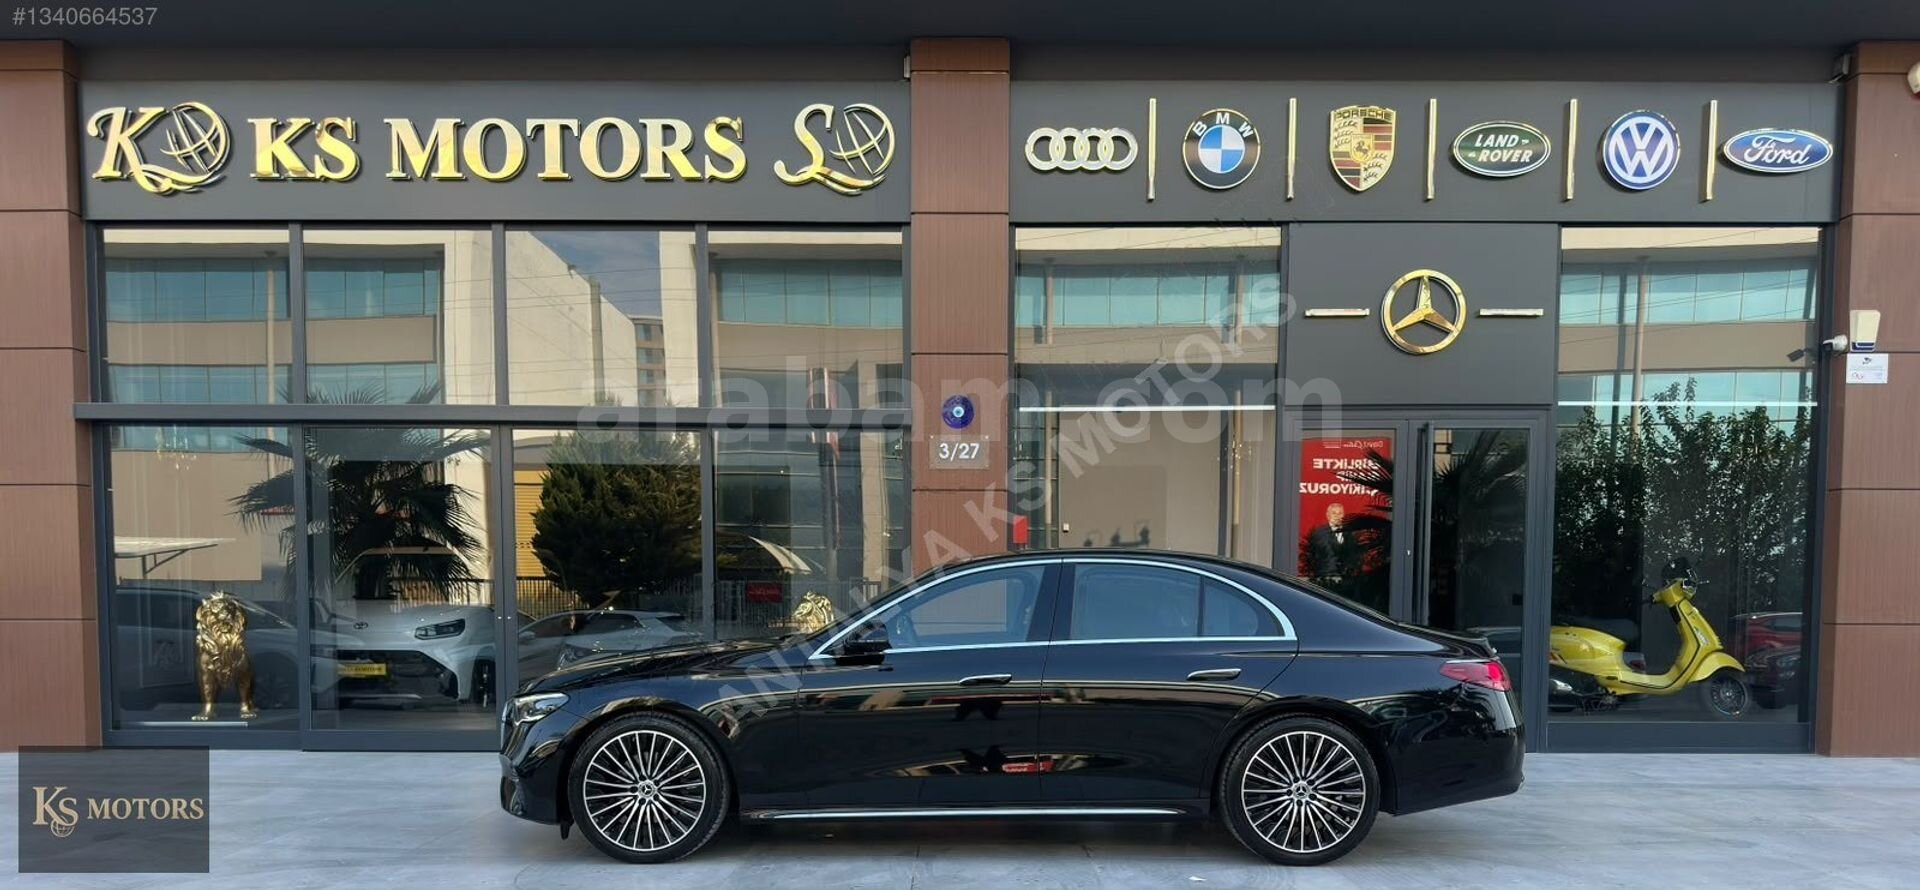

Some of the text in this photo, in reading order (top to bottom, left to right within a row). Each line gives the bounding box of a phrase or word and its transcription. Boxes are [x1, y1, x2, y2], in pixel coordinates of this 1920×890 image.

[1334, 107, 1393, 121] PORSCHE
[1192, 111, 1254, 138] BMW
[247, 116, 747, 182] KS MOTORS
[1475, 134, 1520, 148] LAND
[1743, 135, 1811, 166] Ford
[1478, 149, 1533, 164] ROVER
[938, 443, 980, 462] 3/27
